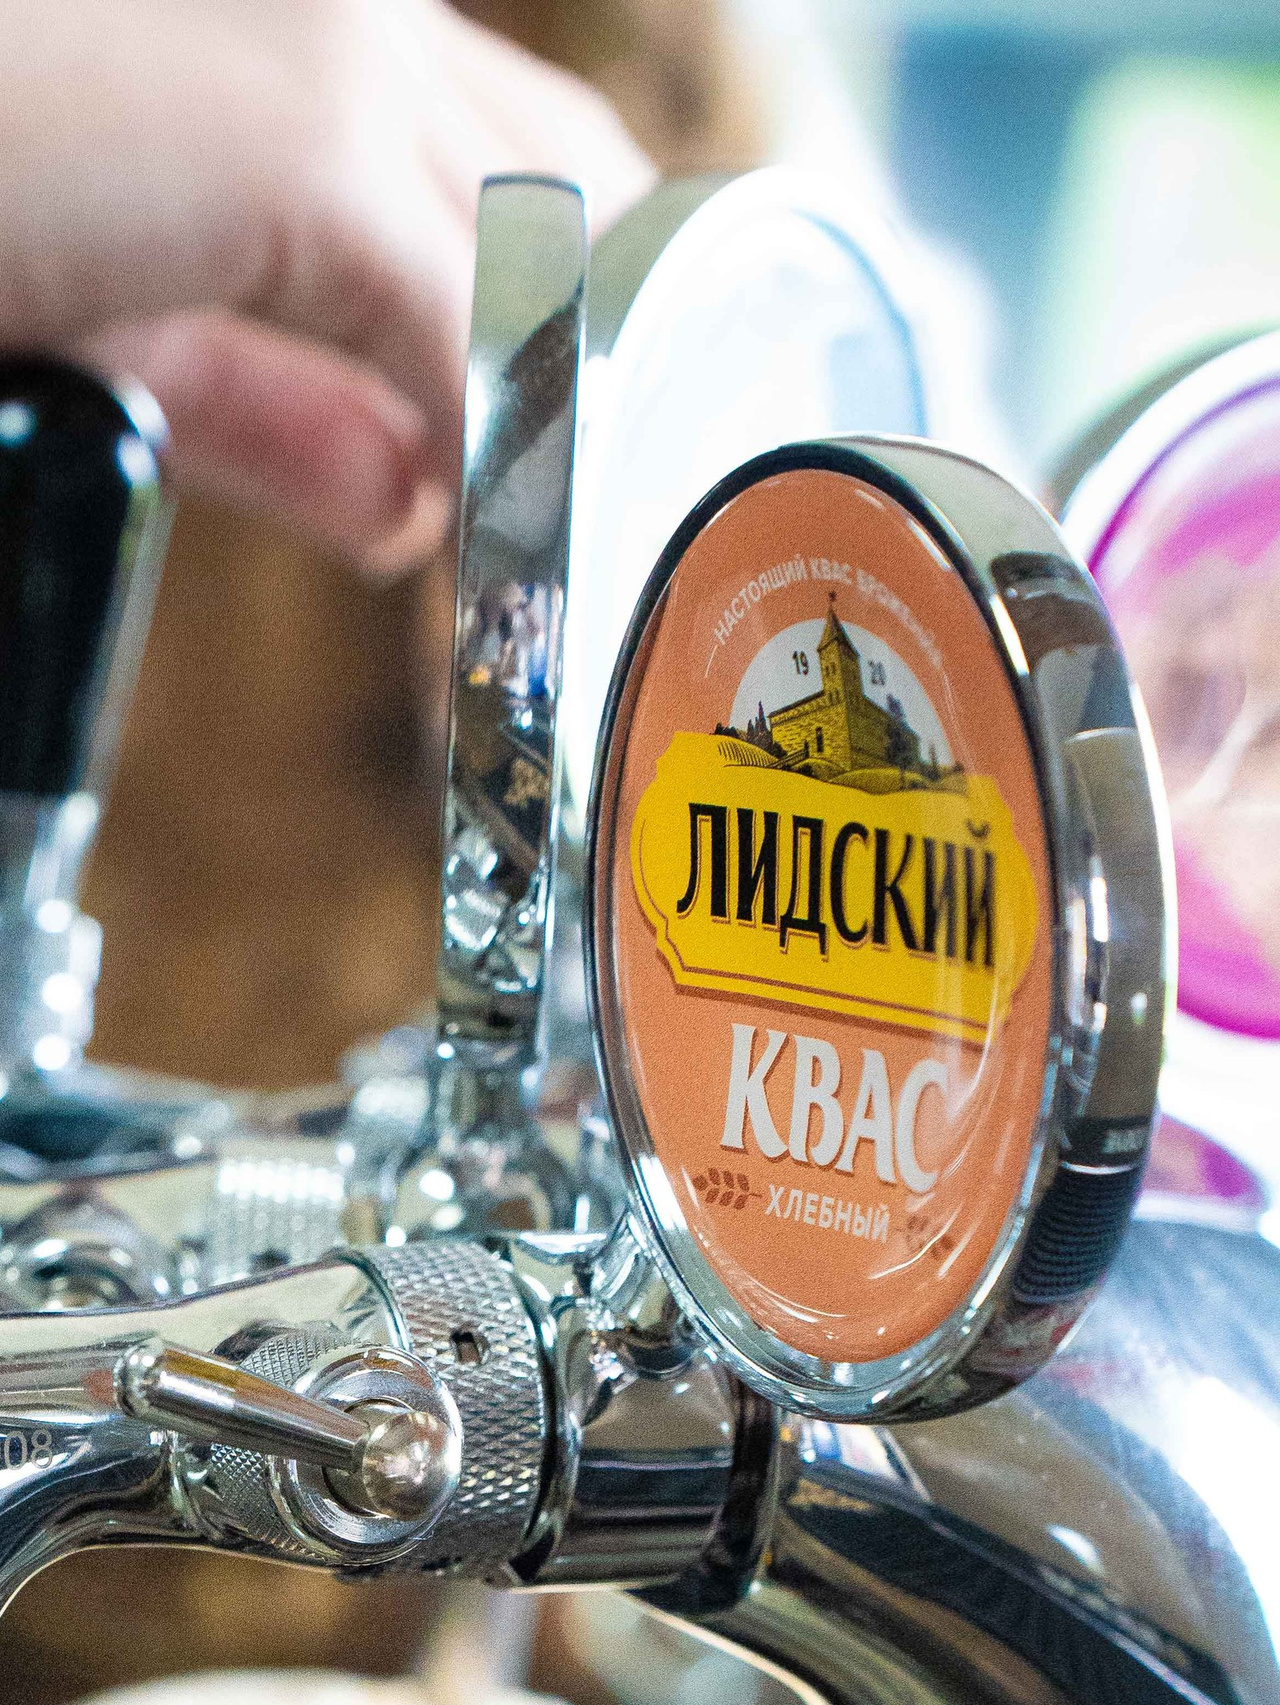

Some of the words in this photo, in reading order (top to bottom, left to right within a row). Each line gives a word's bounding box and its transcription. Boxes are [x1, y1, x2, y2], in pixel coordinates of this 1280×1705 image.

[714, 554, 808, 645] НАСТОЯЩИЙ
[811, 557, 853, 585] КВАС
[792, 650, 810, 676] 19
[676, 803, 997, 968] ЛИДСКИЙ
[720, 1022, 949, 1193] КВАС
[764, 1184, 892, 1243] ХЛЕБНЫЙ
